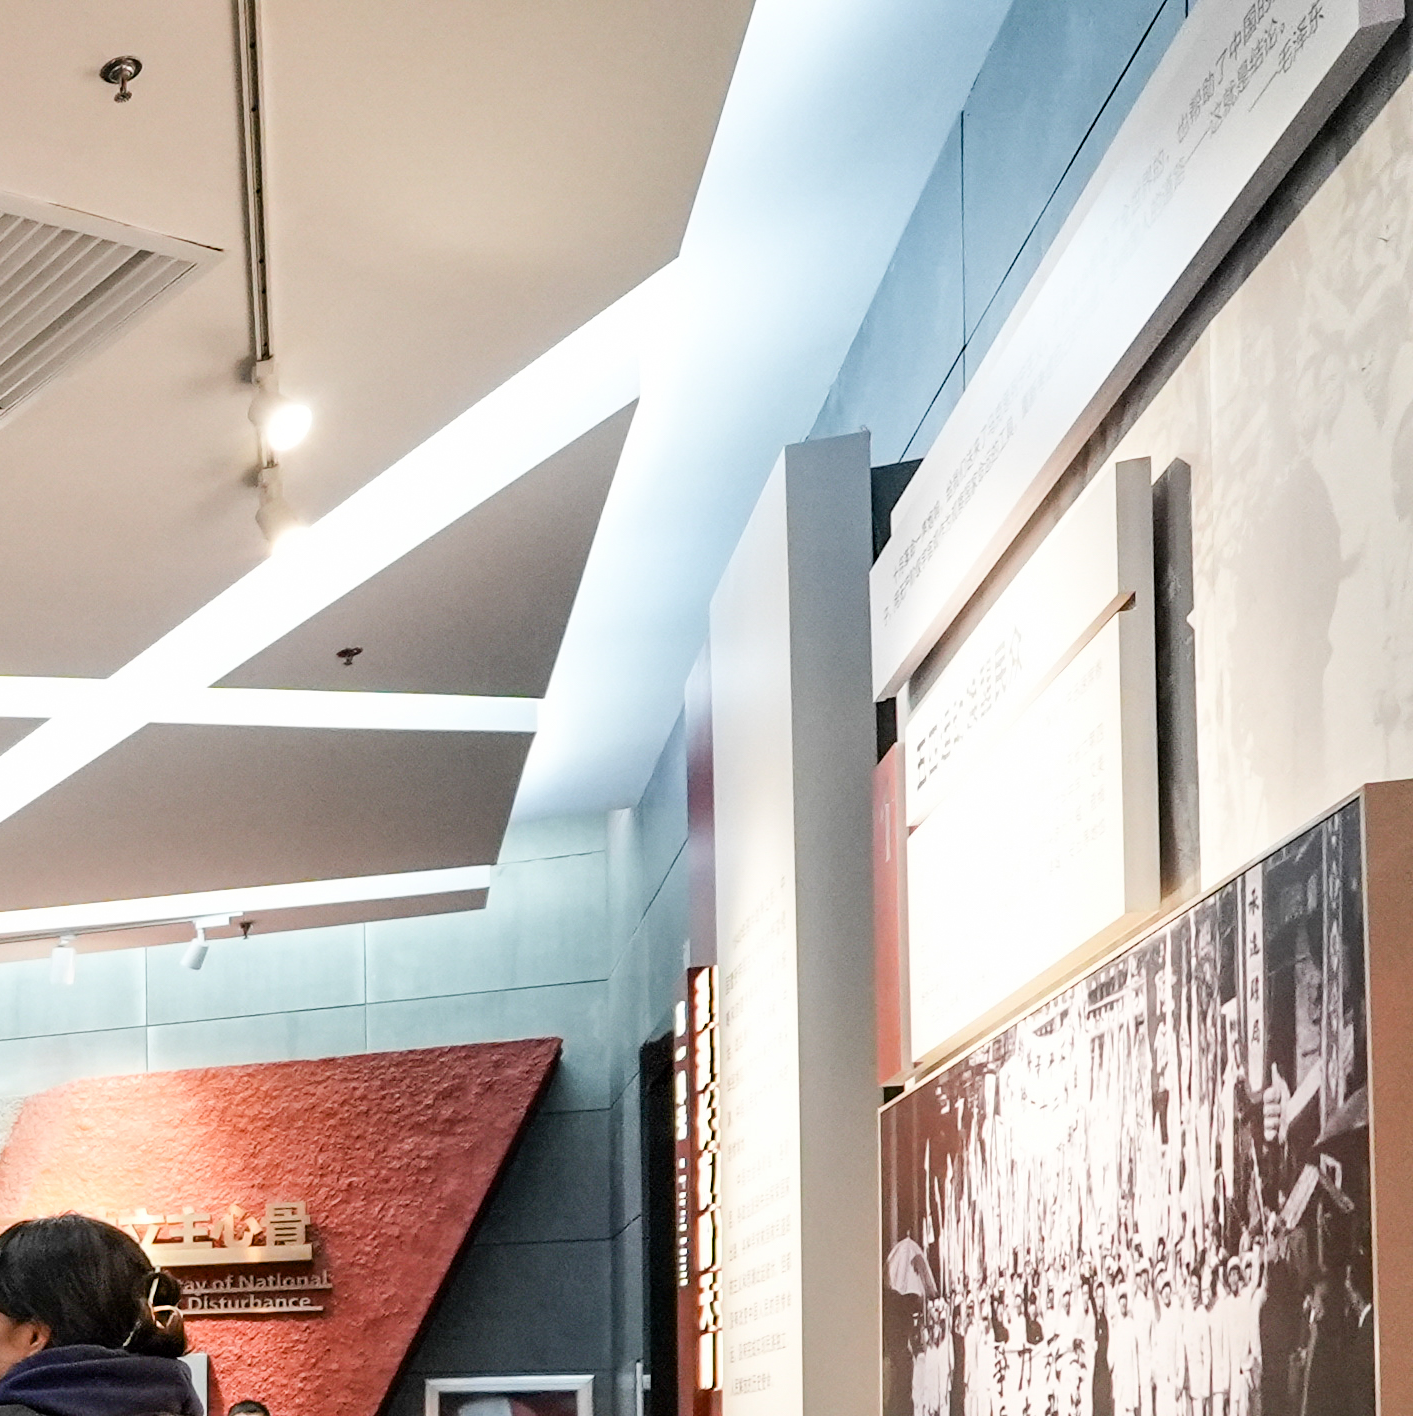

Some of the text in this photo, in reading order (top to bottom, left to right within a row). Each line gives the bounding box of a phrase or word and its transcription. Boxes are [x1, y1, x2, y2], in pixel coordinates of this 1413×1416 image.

[212, 1272, 236, 1290] of
[239, 1270, 330, 1289] National
[187, 1294, 311, 1310] Disturbance
